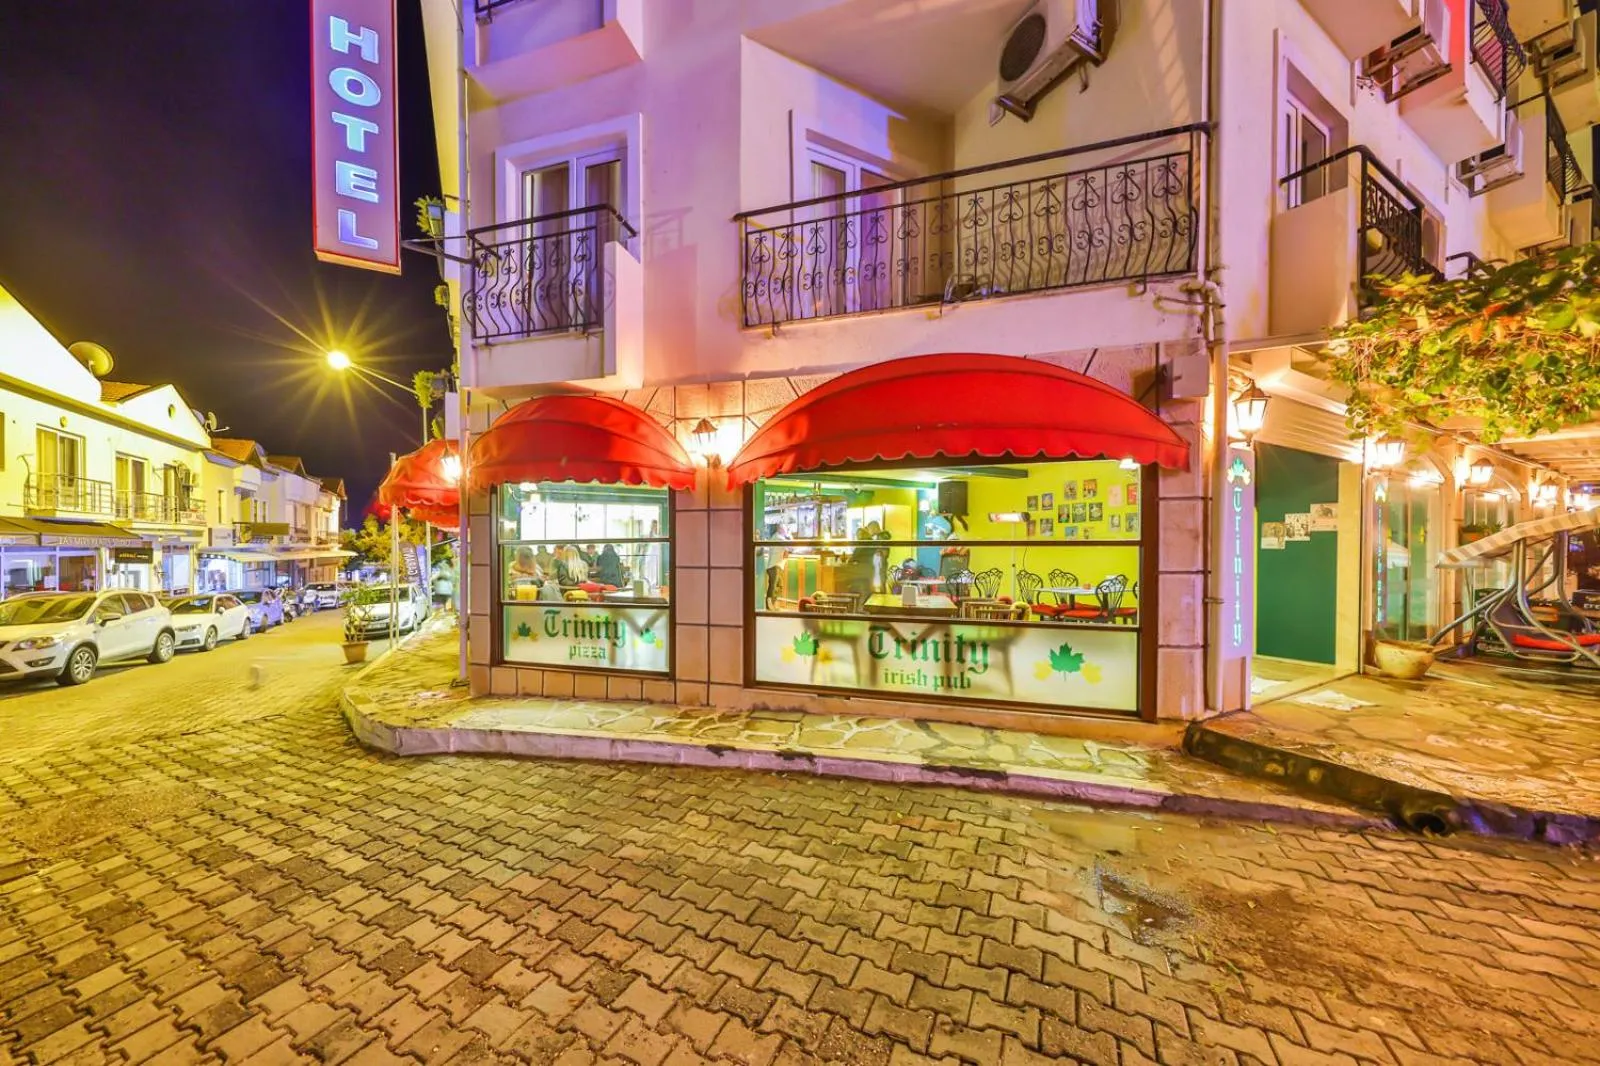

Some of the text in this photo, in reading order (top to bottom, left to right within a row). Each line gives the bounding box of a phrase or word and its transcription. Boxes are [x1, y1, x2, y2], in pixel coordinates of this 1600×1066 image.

[329, 15, 381, 250] HOTEL
[1233, 486, 1243, 647] Trinity
[543, 609, 627, 648] Trinity
[868, 624, 990, 674] Trinity
[568, 642, 607, 660] pizza
[884, 667, 972, 692] irish pub
